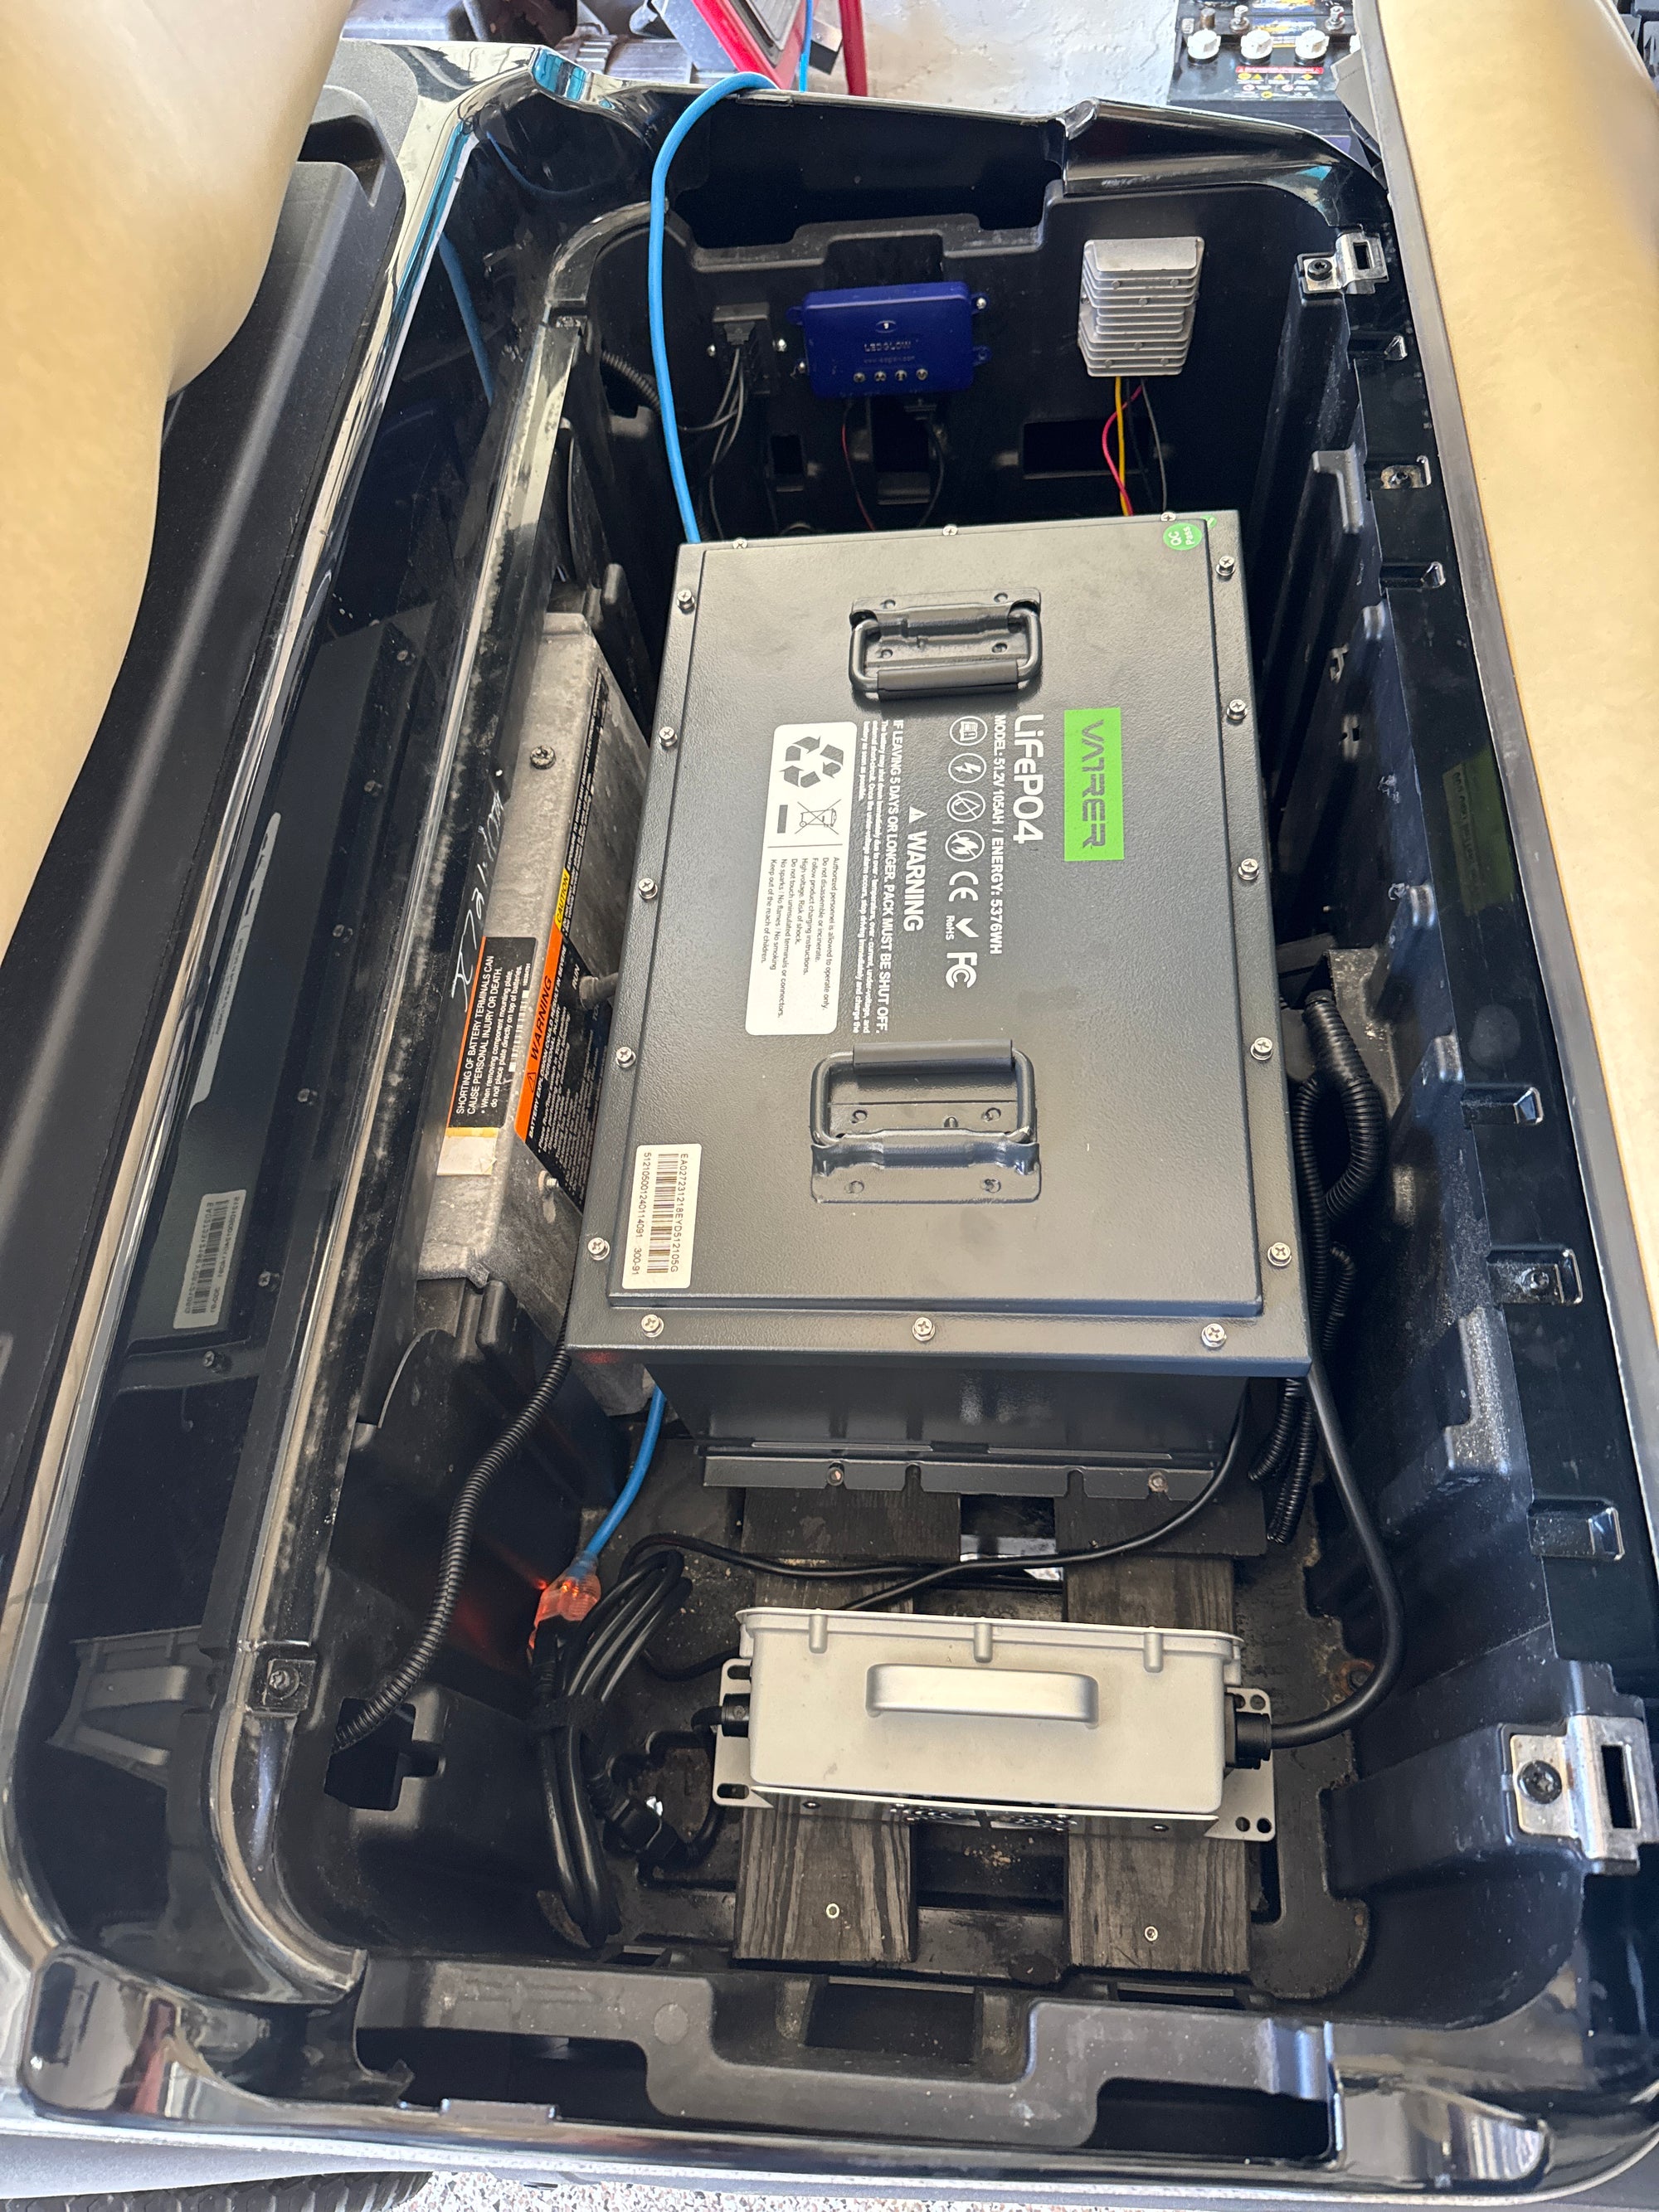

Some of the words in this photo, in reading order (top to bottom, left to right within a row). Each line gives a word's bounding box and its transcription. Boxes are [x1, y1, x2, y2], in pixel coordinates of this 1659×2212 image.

[1168, 531, 1182, 546] QC
[893, 720, 903, 730] IF
[994, 715, 1006, 756] MODEL:
[890, 731, 903, 775] LEAVING
[993, 758, 1005, 786] 51.2V
[1082, 720, 1105, 848] VATRER
[888, 786, 900, 814] DAYS
[992, 790, 1005, 824] 105AH
[887, 816, 898, 833] OR
[768, 859, 777, 875] Keep
[781, 859, 787, 868] No
[791, 858, 798, 867] Do
[800, 858, 808, 873] High
[822, 858, 829, 866] Do
[831, 857, 839, 891] Authorized
[990, 838, 1004, 895] ENERGY:
[798, 874, 806, 898] voltage.
[903, 831, 927, 931] WARNING
[949, 871, 979, 902] CE
[557, 873, 568, 923] CAUTION
[777, 895, 784, 903] No
[819, 879, 827, 918] disassemble
[883, 884, 895, 916] PACK
[786, 900, 794, 936] uninsulated
[805, 906, 815, 933] charging
[946, 916, 955, 941] RoHS
[990, 899, 1002, 954] 5376WH
[775, 931, 781, 941] No
[815, 929, 824, 962] incinerate.
[881, 918, 893, 950] MUST
[761, 936, 770, 963] children.
[771, 942, 779, 970] smoking
[782, 938, 791, 968] terminals
[804, 936, 813, 975] instructions.
[880, 954, 892, 970] BE
[484, 956, 494, 972] CAN
[503, 970, 513, 986] plate,
[489, 967, 503, 994] DEATH.
[510, 965, 522, 994] batteries.
[878, 972, 890, 1004] SHUT
[474, 974, 491, 1018] TERMINALS
[487, 995, 497, 1008] OR
[499, 988, 511, 1017] mounting
[507, 1003, 517, 1013] top
[778, 979, 786, 1018] connectors.
[821, 994, 830, 1010] only.
[481, 1010, 494, 1038] INJURY
[507, 1014, 513, 1023] on
[531, 975, 551, 1060] WARNING
[876, 1007, 888, 1033] OFF.
[467, 1019, 483, 1055] BATTERY
[492, 1018, 504, 1054] component
[500, 1024, 513, 1048] directly
[544, 1037, 555, 1081] PERSONAL
[551, 1004, 561, 1034] INJURY
[465, 1057, 475, 1069] OF
[473, 1040, 489, 1084] PERSONAL
[486, 1056, 499, 1086] removing
[498, 1049, 507, 1065] plate
[528, 1100, 539, 1138] BATTERY
[536, 1049, 548, 1098] EXPLOSION
[544, 1018, 553, 1051] COULD
[550, 987, 559, 1018] RESULT
[494, 1067, 504, 1084] place
[455, 1071, 473, 1114] SHORTING
[467, 1087, 480, 1114] CAUSE
[480, 1088, 491, 1107] When
[489, 1099, 499, 1107] do
[493, 1087, 501, 1096] not
[632, 1247, 641, 1275] 300-91
